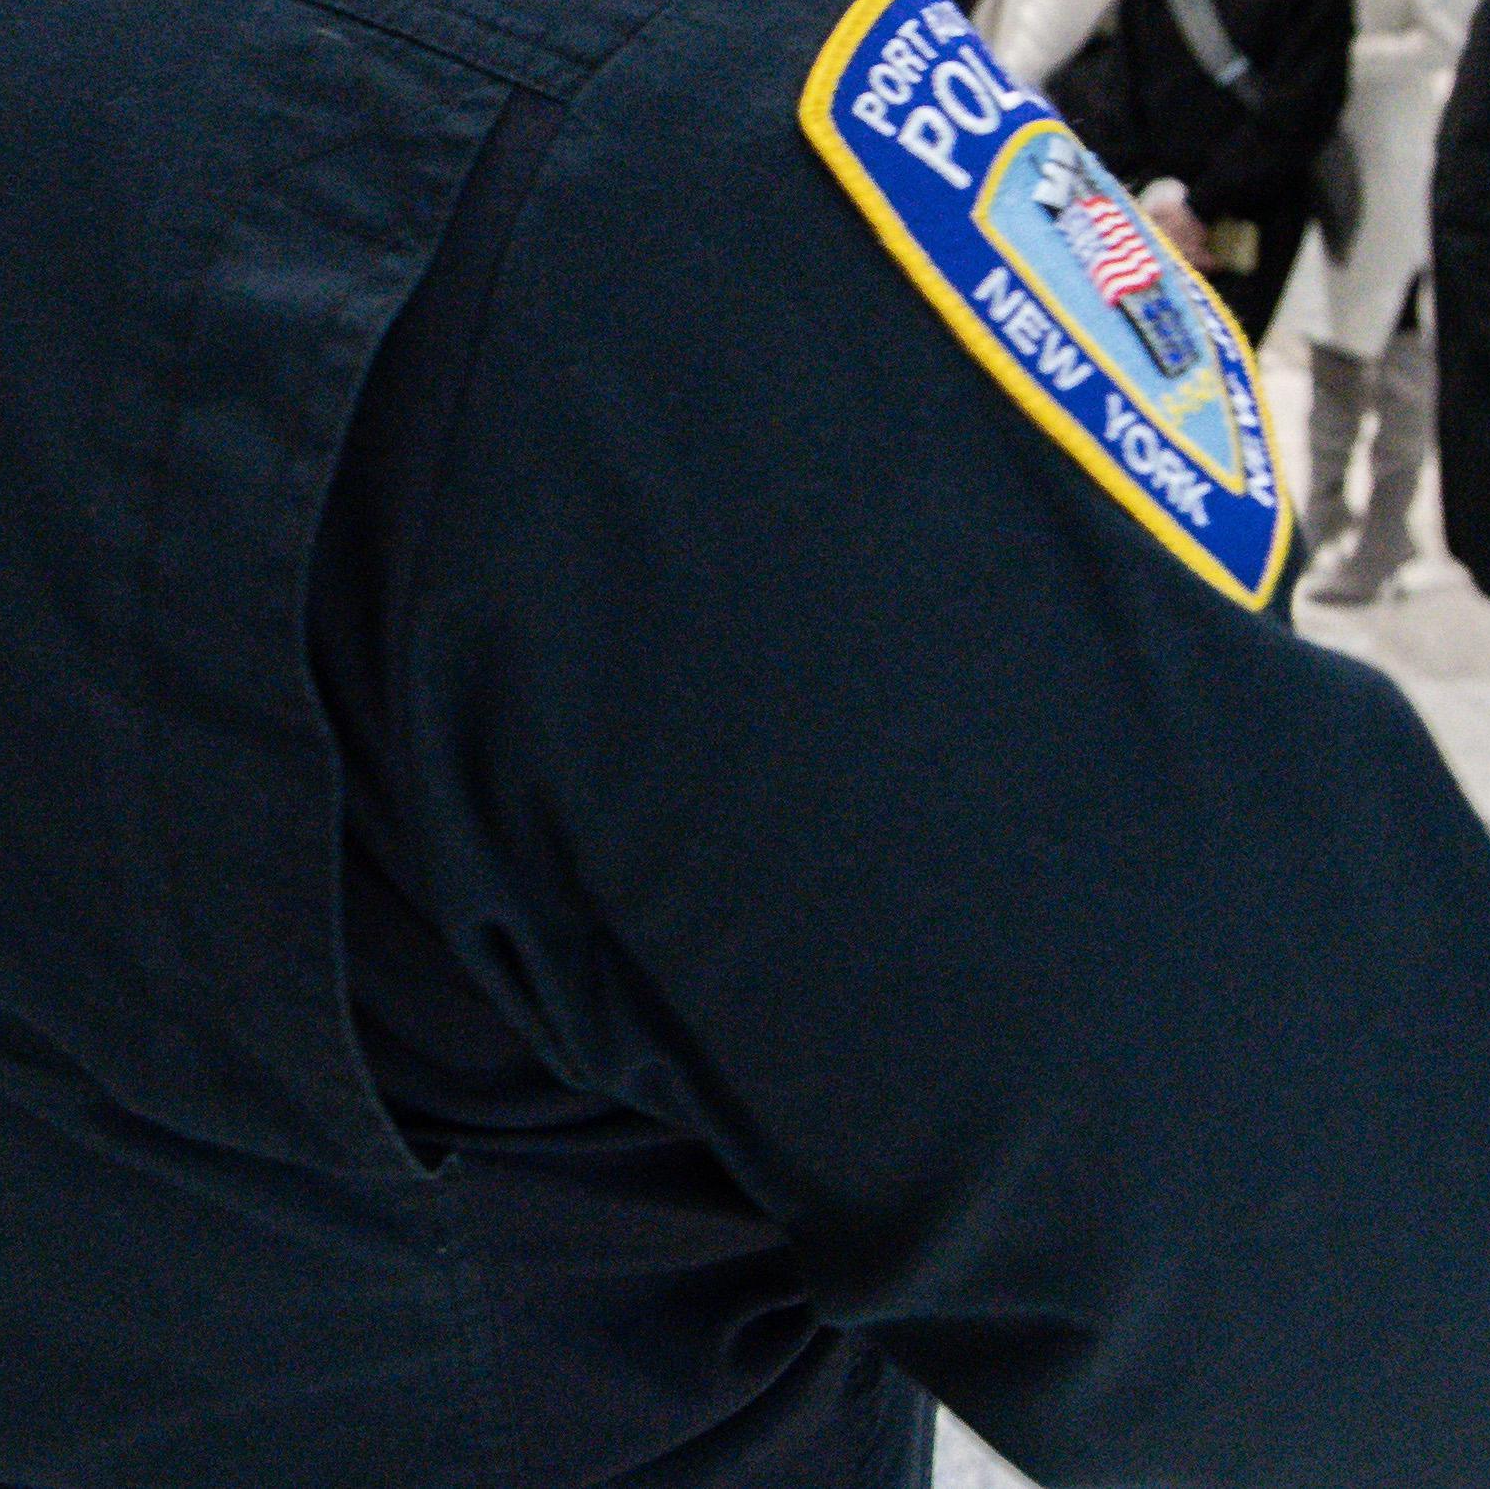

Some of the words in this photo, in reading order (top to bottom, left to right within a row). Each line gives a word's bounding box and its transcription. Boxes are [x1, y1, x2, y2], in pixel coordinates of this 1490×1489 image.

[851, 18, 939, 137] PORT
[972, 266, 1094, 391] NEW
[1104, 393, 1212, 527] YORK
